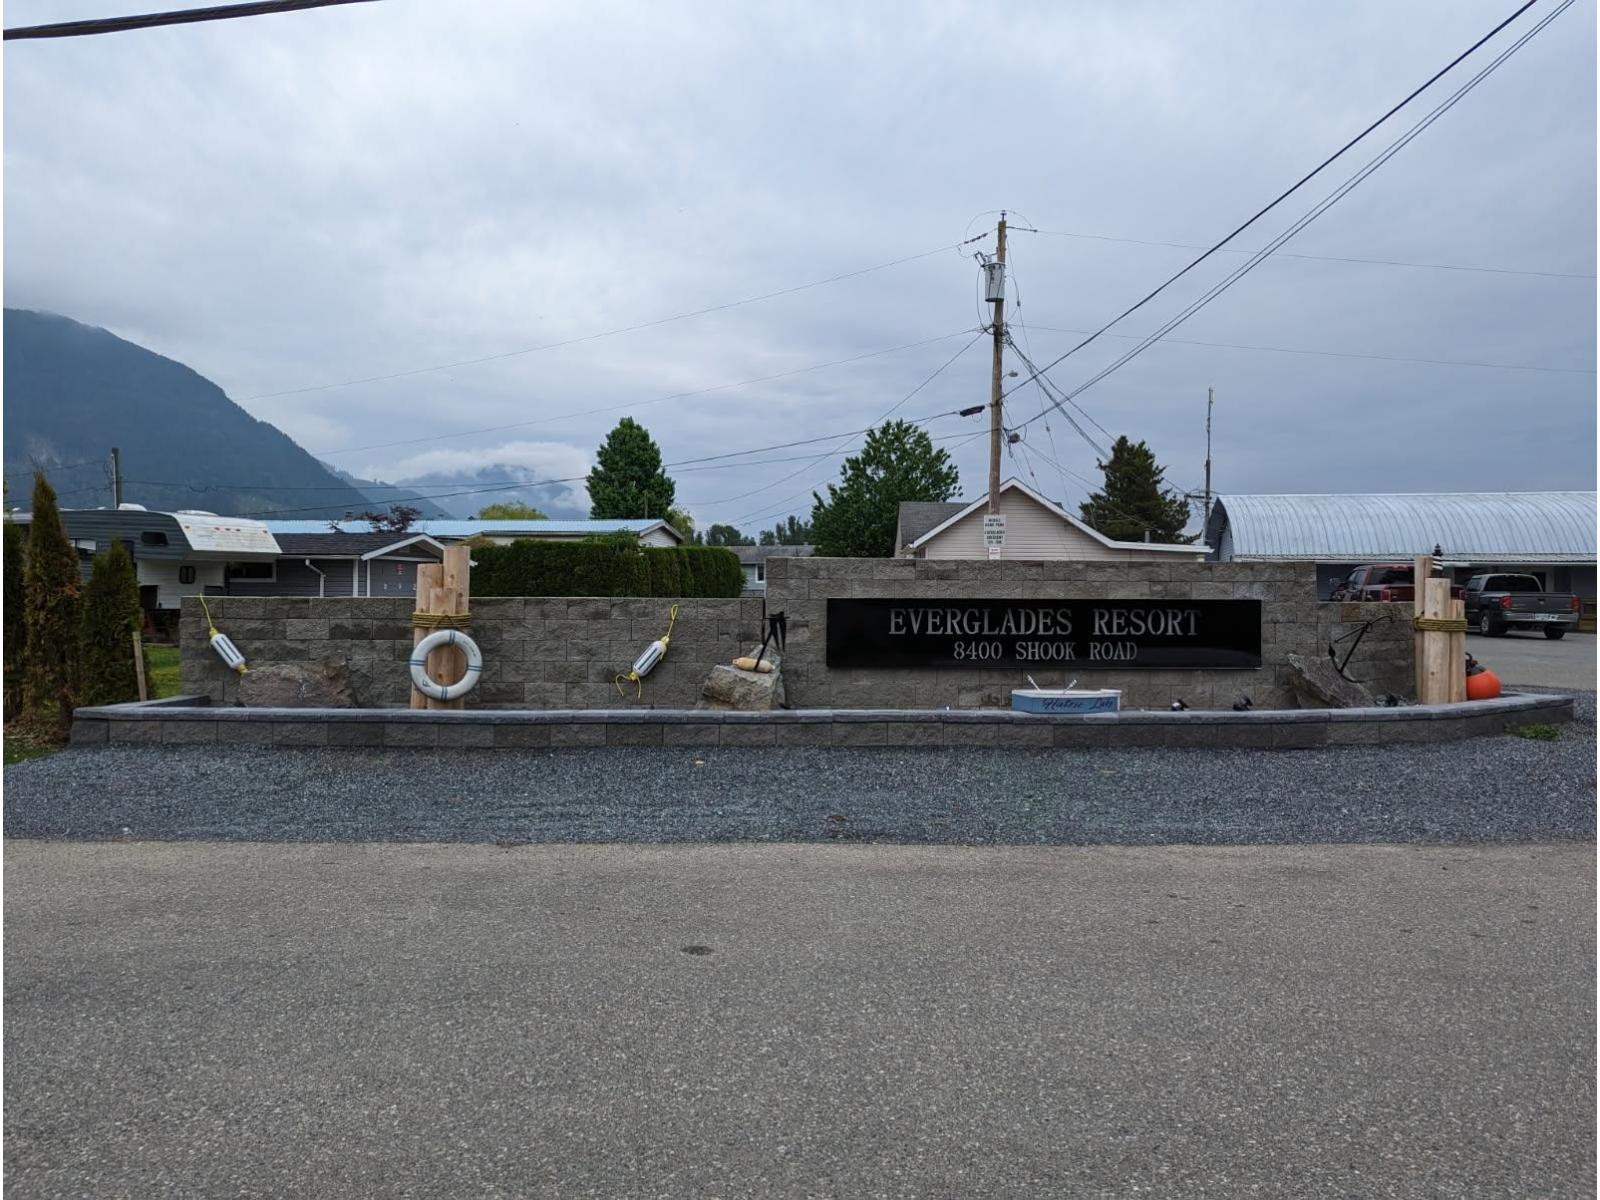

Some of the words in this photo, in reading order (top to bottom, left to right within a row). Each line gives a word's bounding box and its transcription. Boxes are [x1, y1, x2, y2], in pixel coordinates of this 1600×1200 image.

[888, 608, 1073, 636] EVERGLADES
[1092, 608, 1201, 636] RESORT
[953, 641, 1002, 660] 8400
[1015, 641, 1076, 660] SHOOK
[1088, 641, 1138, 660] ROAD
